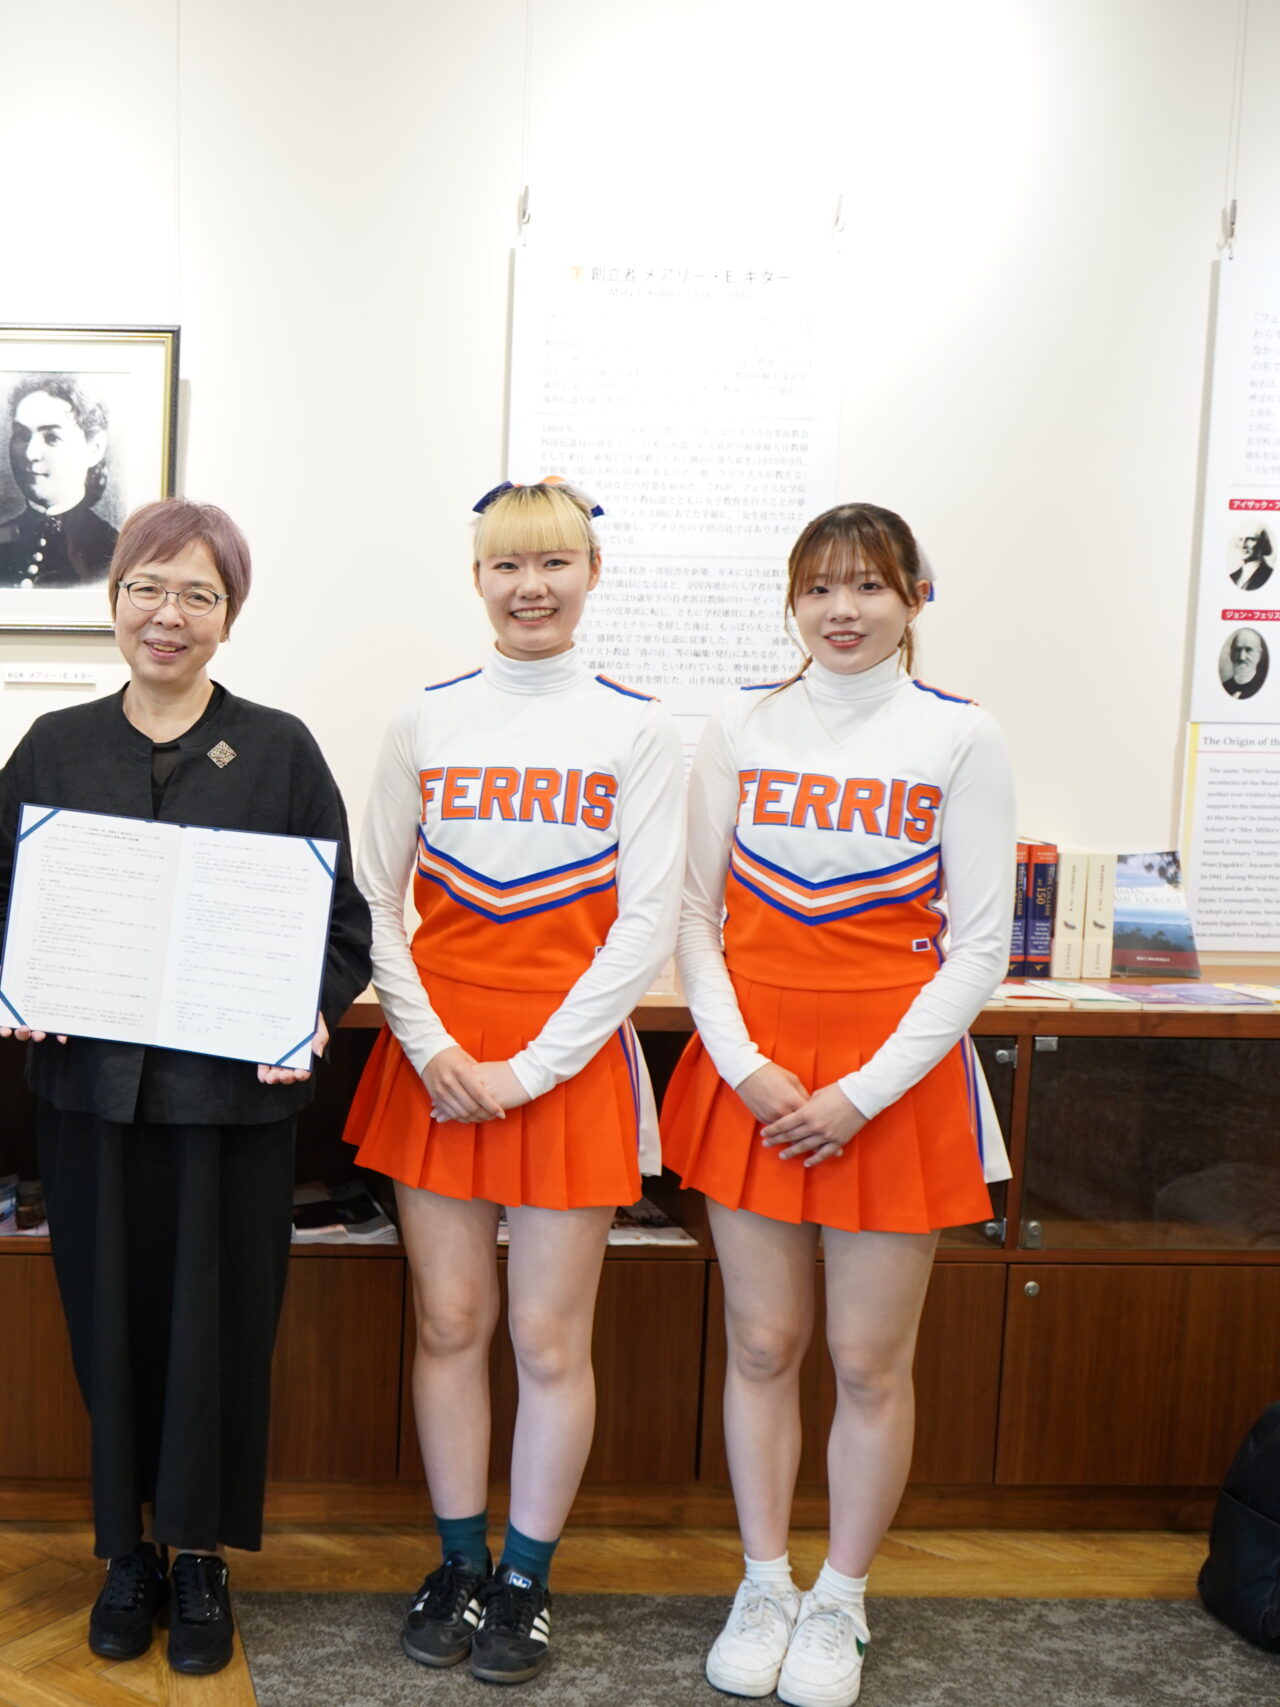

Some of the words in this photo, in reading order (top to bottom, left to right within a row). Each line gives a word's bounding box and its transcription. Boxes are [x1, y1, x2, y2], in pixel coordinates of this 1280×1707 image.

[1223, 736, 1255, 749] Origin
[1258, 737, 1268, 746] of
[419, 766, 619, 832] FERRIS
[737, 768, 943, 845] FERRIS
[1036, 887, 1046, 905] 150
